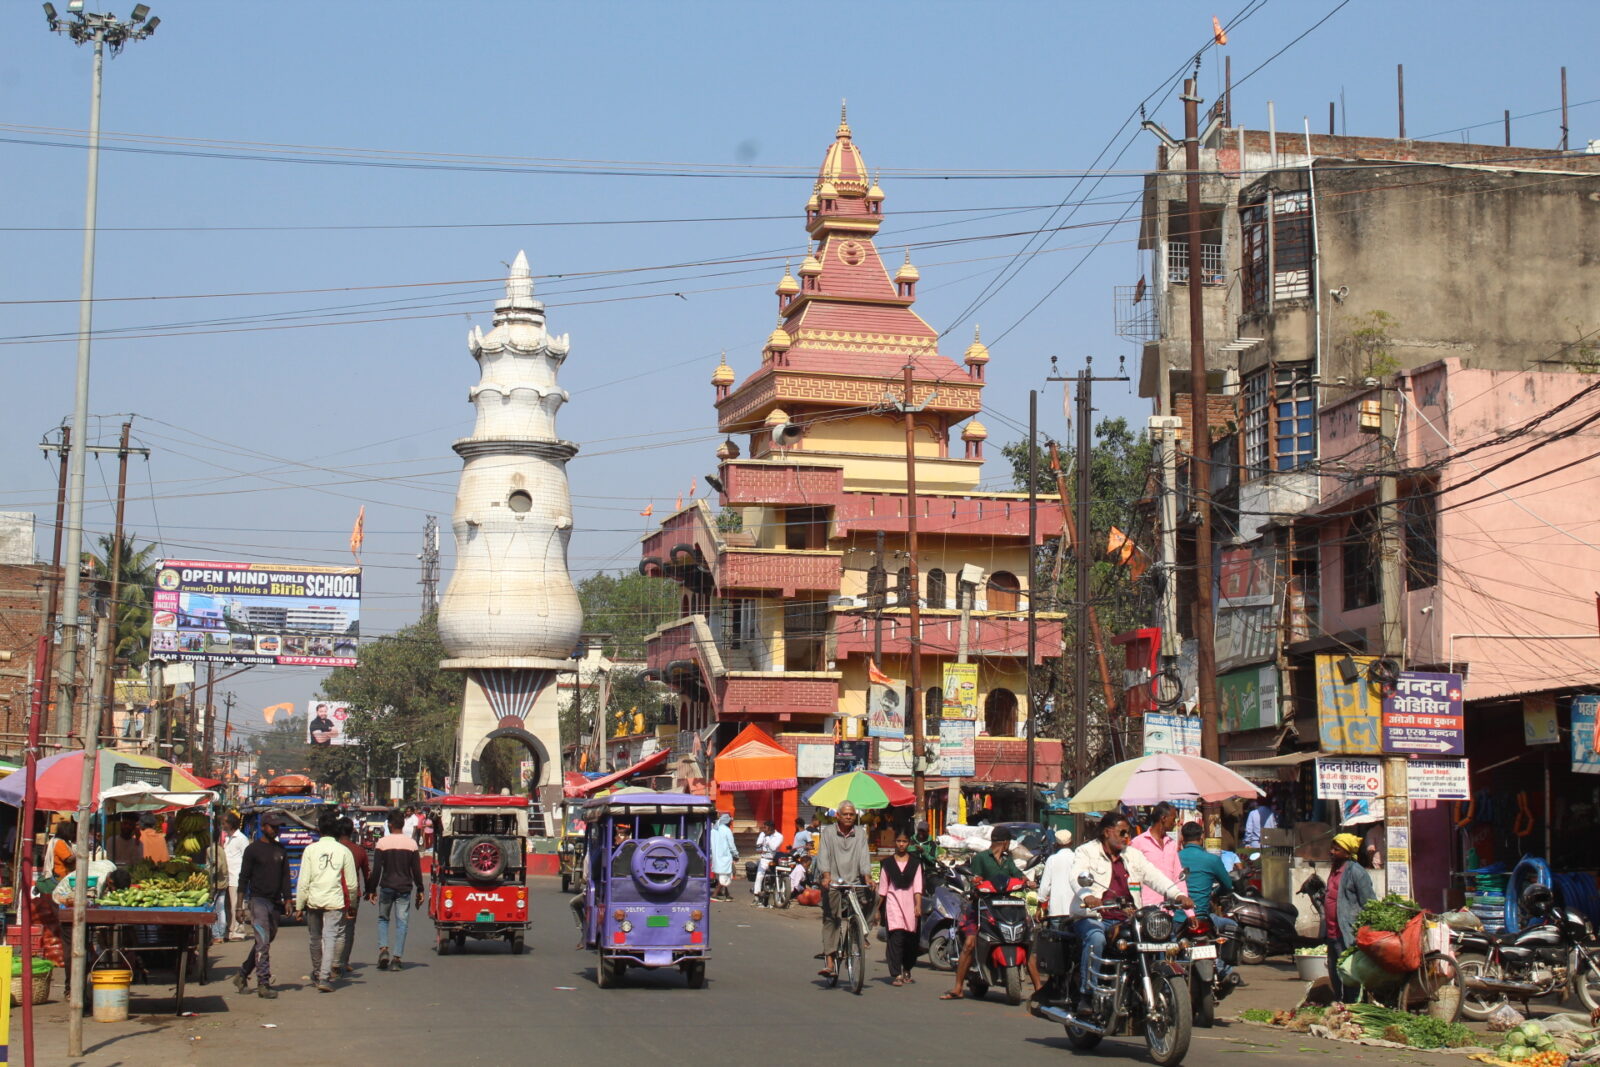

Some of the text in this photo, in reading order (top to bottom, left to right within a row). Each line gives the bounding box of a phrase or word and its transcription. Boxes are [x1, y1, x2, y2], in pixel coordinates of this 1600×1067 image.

[182, 569, 360, 598] OPEN MIND WORLD SCHOOL
[182, 585, 207, 593] Formerly
[207, 584, 231, 594] Open
[233, 585, 261, 595] Minds
[270, 583, 305, 596] Birla
[153, 653, 178, 661] NEAR
[180, 654, 206, 662] TOWN
[242, 656, 274, 664] GIRIDIH
[1397, 678, 1449, 697] नन्दन
[1393, 695, 1451, 714] मेडिसिन
[1319, 760, 1378, 773] नन्दन मेडिसिन
[465, 892, 505, 902] ATUL
